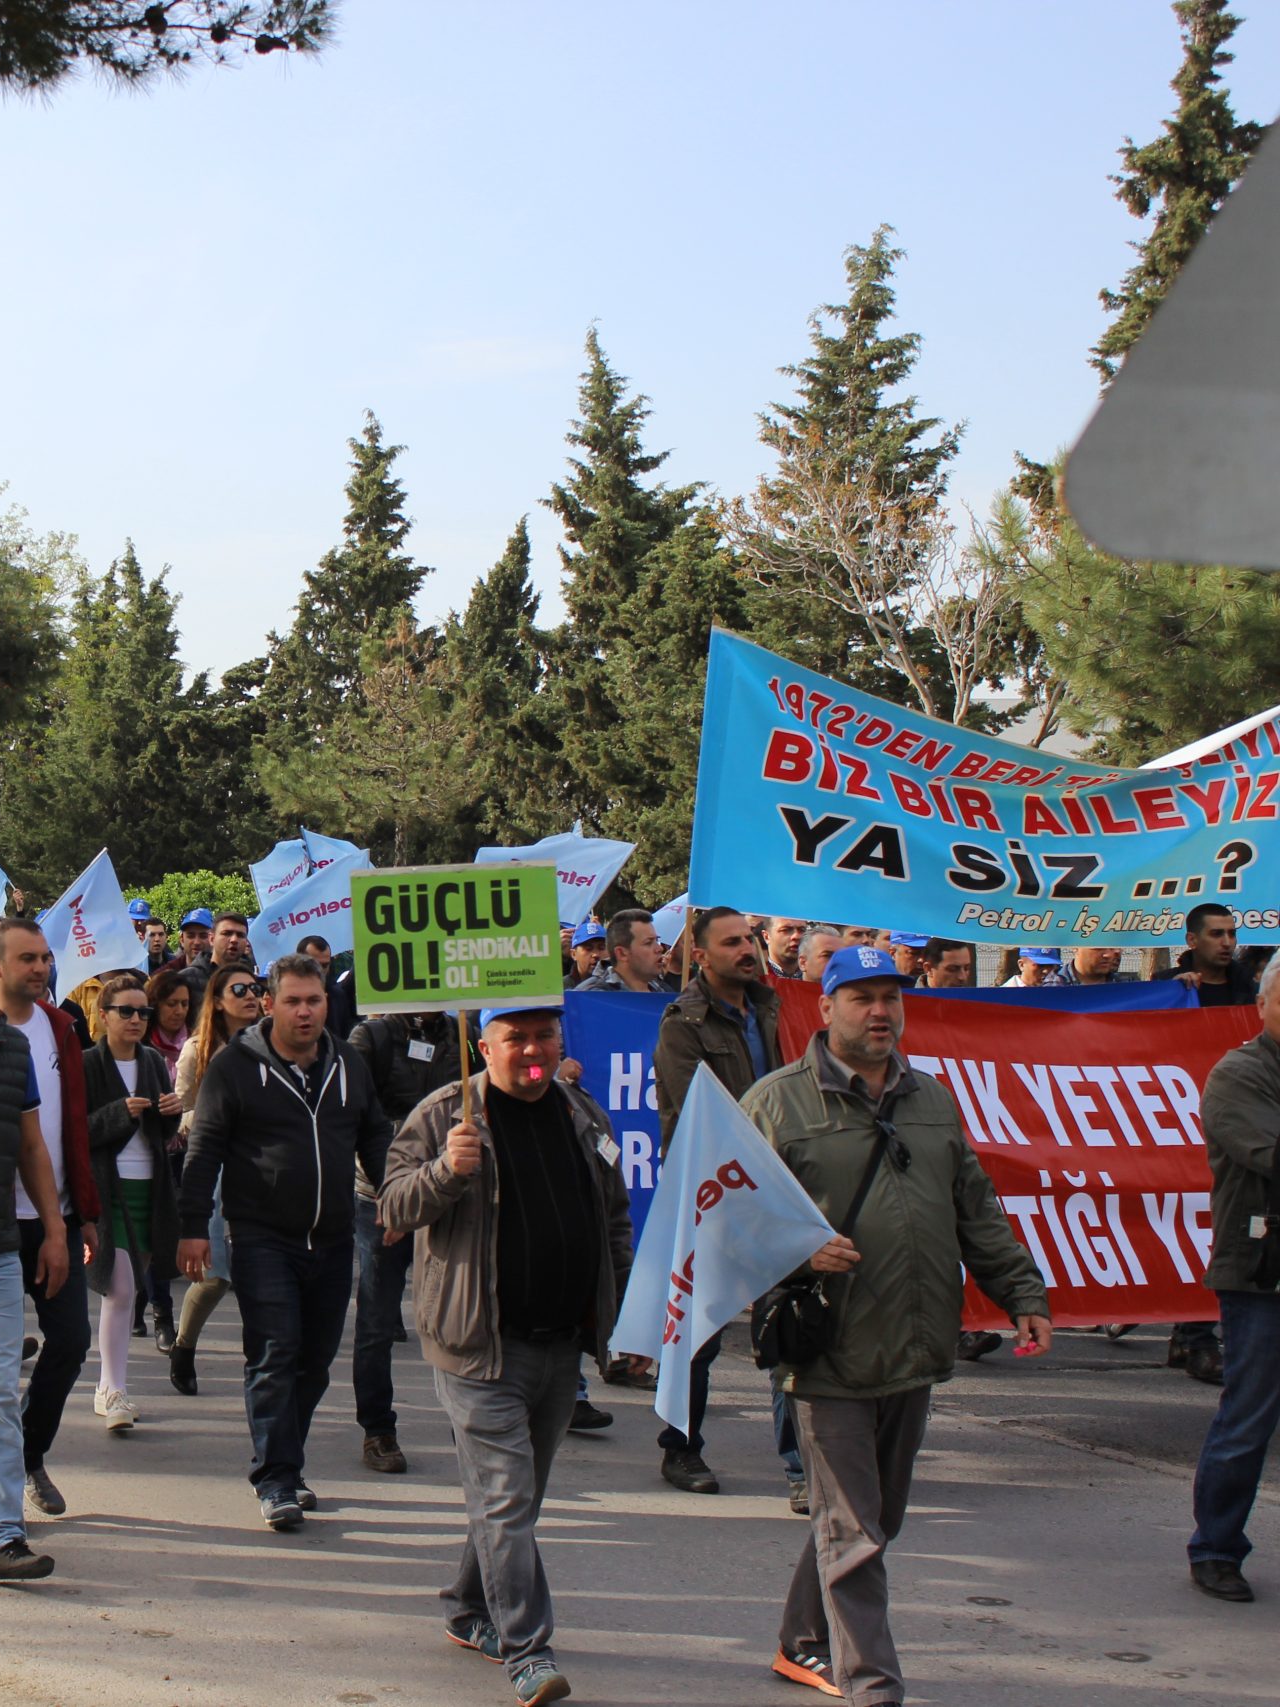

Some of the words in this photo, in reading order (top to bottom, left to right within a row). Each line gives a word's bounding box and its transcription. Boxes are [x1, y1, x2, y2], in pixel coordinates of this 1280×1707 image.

[768, 678, 954, 771] 1972'DEN
[950, 752, 1064, 788] BERİ
[762, 729, 883, 802] BİZ
[888, 771, 1004, 833] BİR
[1022, 764, 1280, 837] AİLEYİZ
[779, 805, 908, 880] YA
[947, 839, 1105, 899] SİZ
[363, 878, 523, 937] GÜÇLÜ
[956, 902, 1053, 931] Petrol
[1072, 906, 1101, 937] İş
[1102, 908, 1185, 936] Aliağa
[366, 940, 441, 993] OL!
[444, 965, 480, 990] OL!
[1010, 1061, 1206, 1148] YETER
